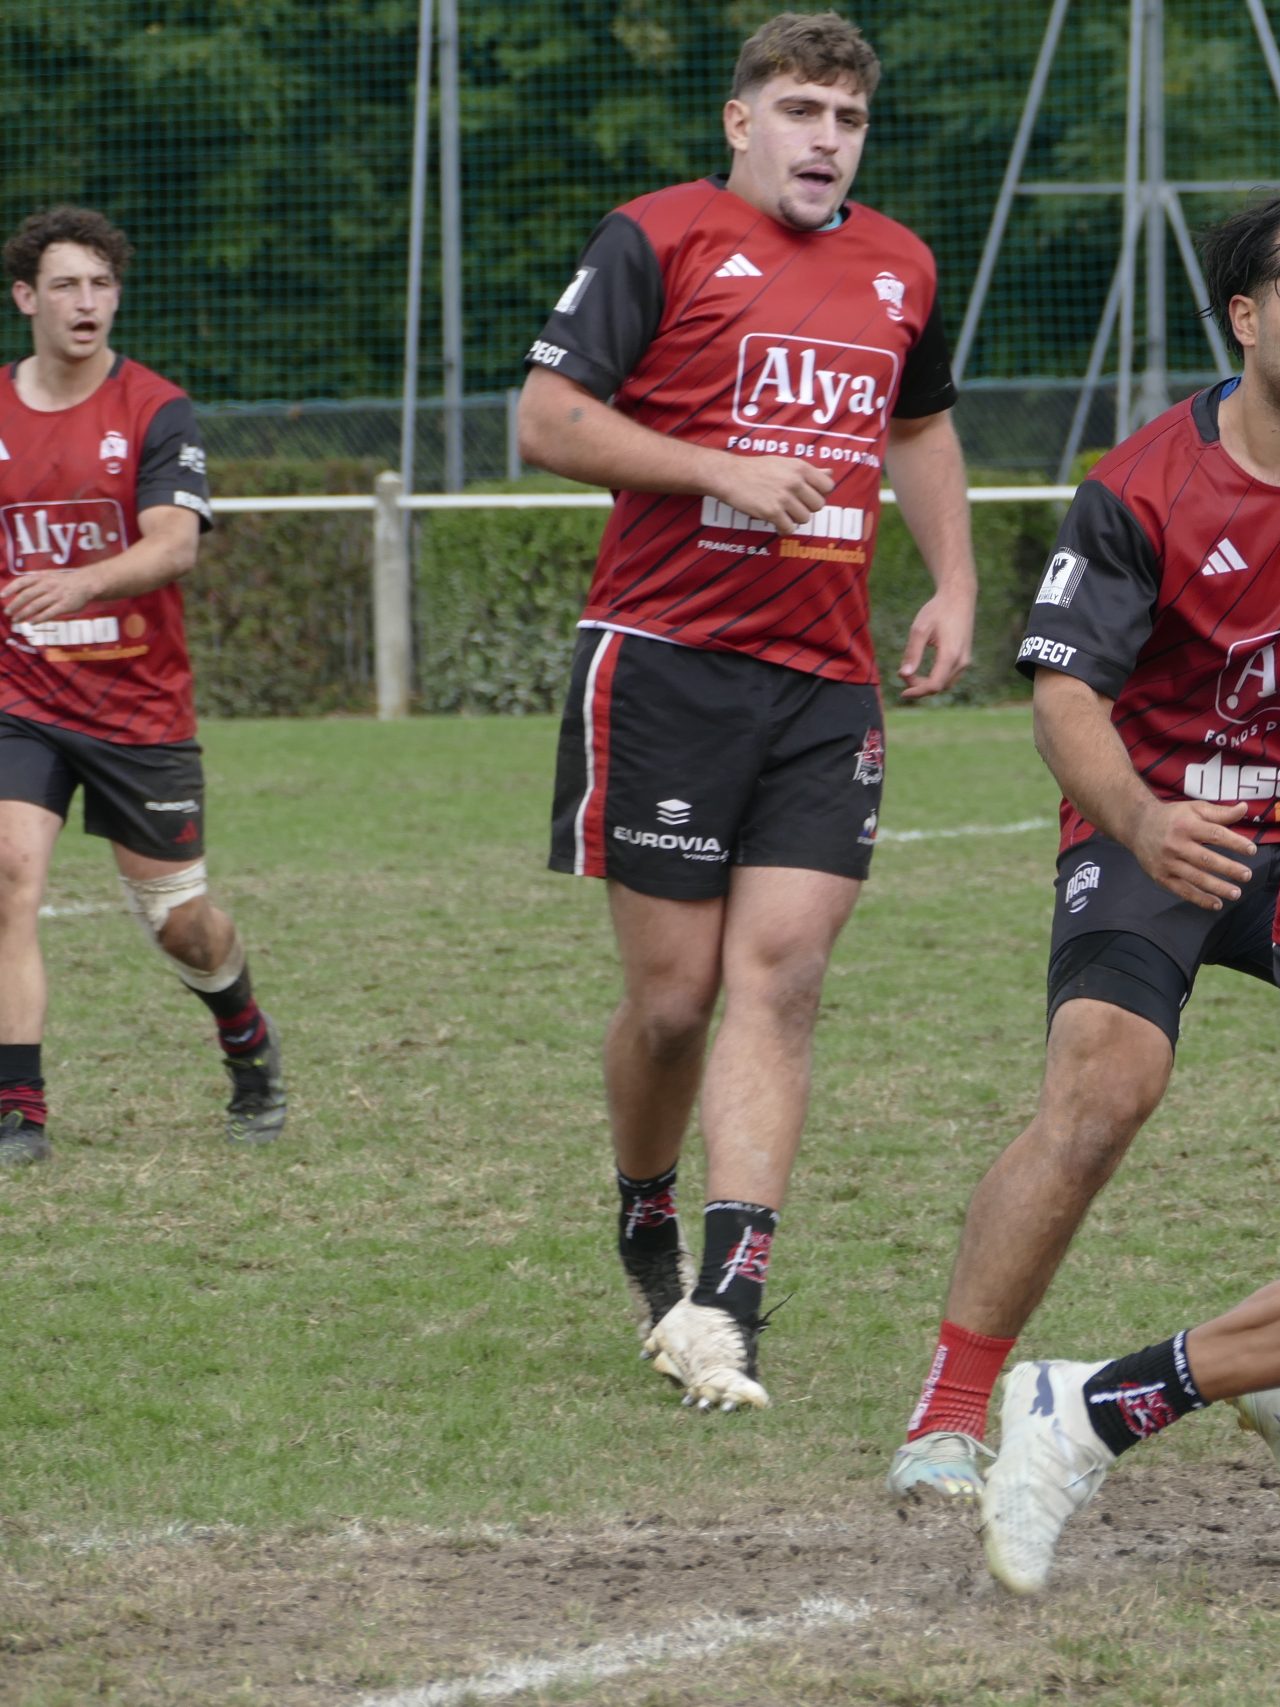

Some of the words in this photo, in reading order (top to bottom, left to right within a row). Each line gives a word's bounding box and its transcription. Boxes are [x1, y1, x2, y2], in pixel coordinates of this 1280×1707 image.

[742, 347, 887, 424] Alya.
[727, 436, 789, 454] FONDS
[794, 443, 816, 457] DE
[613, 826, 722, 853] EUROVIA
[1064, 866, 1101, 904] RCSR
